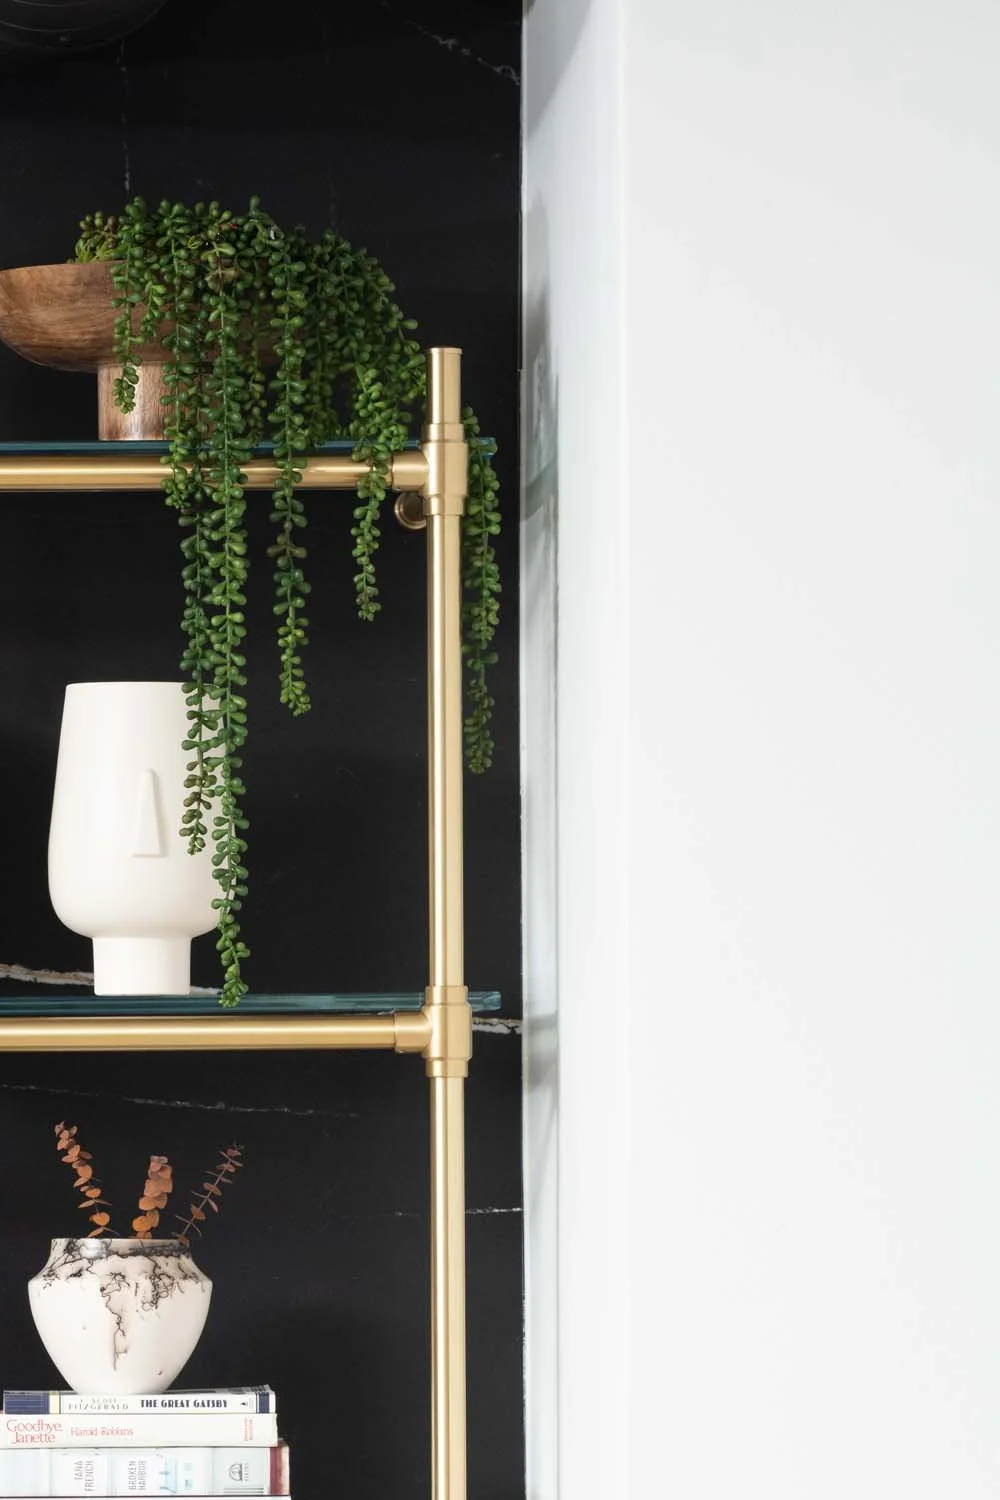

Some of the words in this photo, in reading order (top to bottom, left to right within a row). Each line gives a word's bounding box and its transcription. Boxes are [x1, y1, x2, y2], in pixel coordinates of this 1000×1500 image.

[140, 1399, 157, 1408] THE
[160, 1399, 191, 1408] GREAT
[193, 1399, 228, 1408] GATSBY
[11, 1431, 56, 1444] Janette
[70, 1426, 98, 1437] Harold
[101, 1426, 134, 1437] Robbins
[85, 1459, 95, 1492] FRENCH
[128, 1460, 137, 1490] BROKEN
